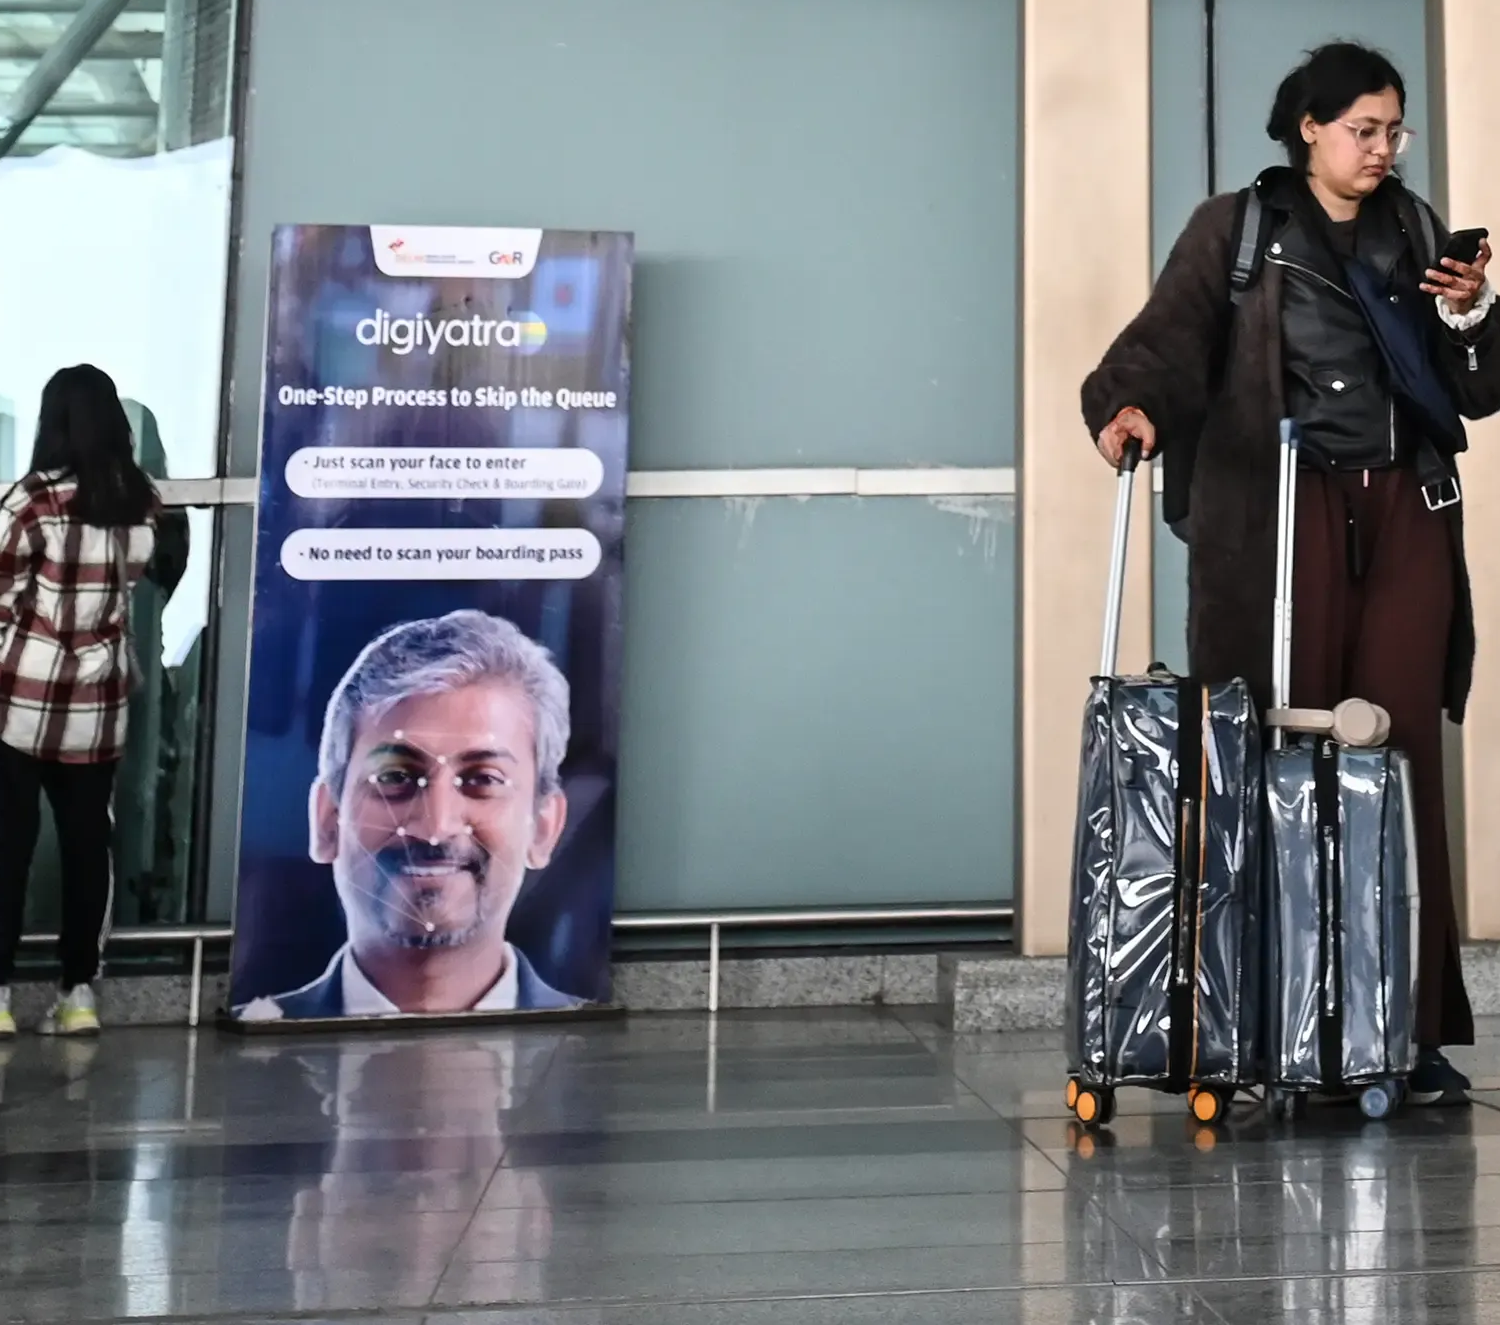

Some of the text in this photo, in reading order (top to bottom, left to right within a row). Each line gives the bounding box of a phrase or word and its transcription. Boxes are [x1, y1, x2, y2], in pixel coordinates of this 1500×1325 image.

[356, 308, 521, 355] digiyatra
[278, 386, 616, 411] One-Step Process to Skip the Queue
[313, 456, 526, 472] Just scan your face to enter
[309, 545, 583, 563] No need to scan your boarding pass
